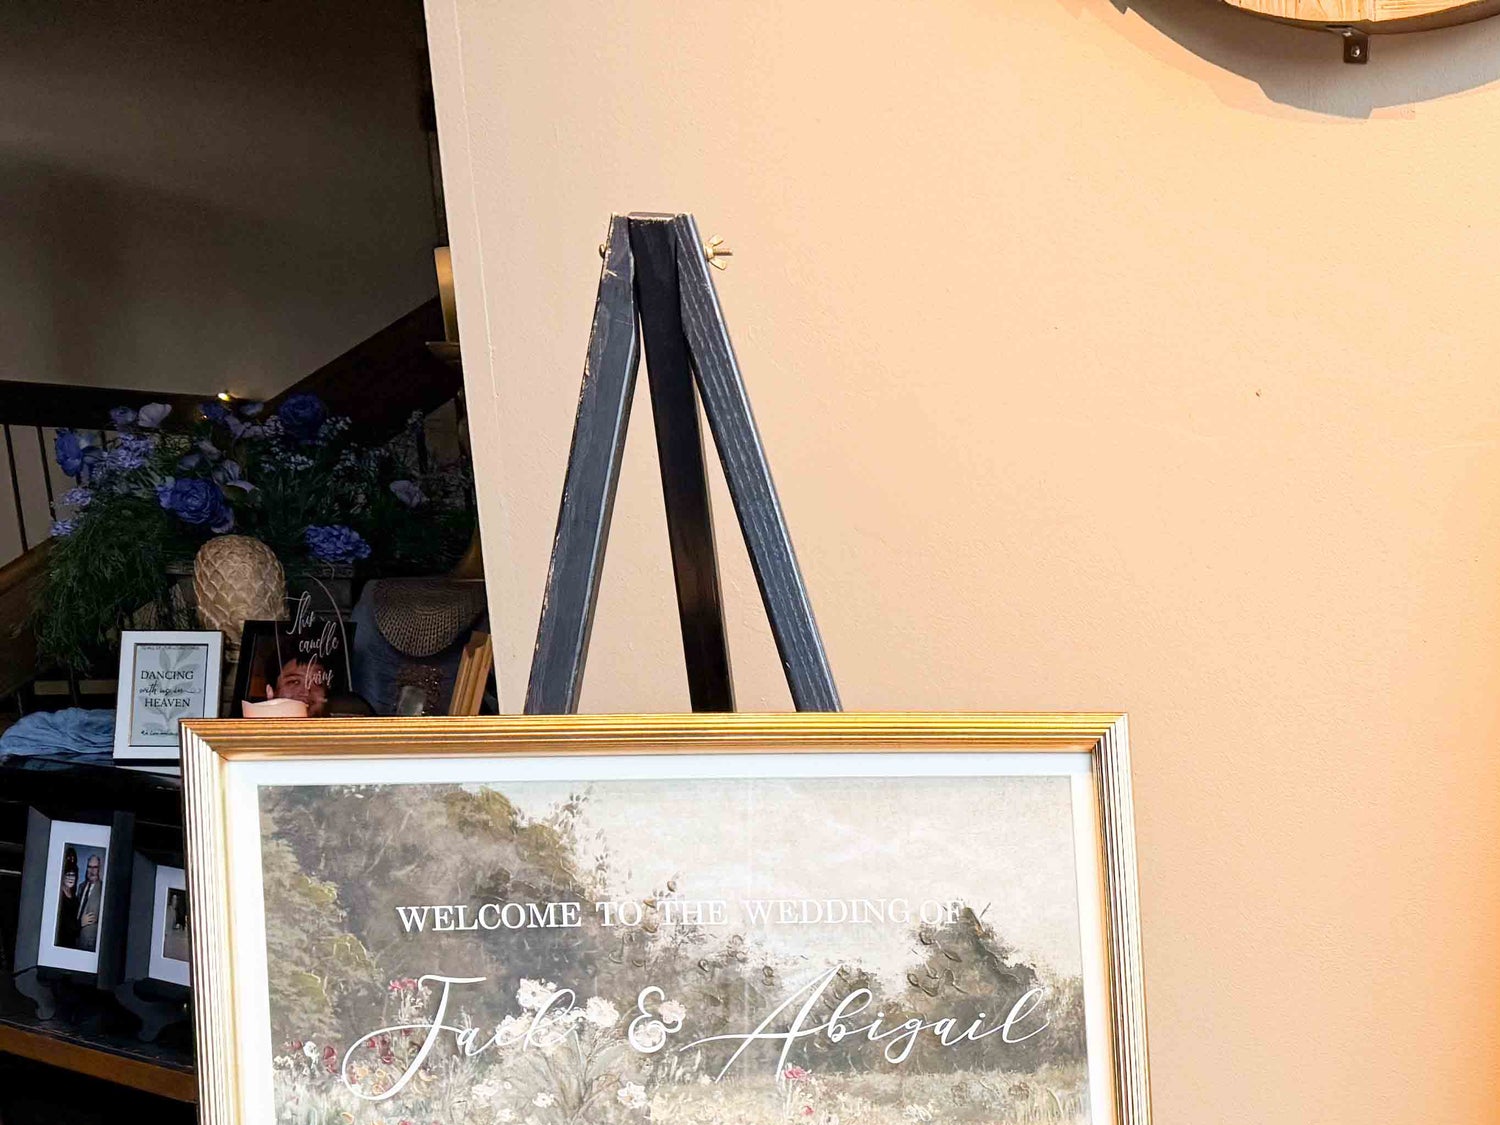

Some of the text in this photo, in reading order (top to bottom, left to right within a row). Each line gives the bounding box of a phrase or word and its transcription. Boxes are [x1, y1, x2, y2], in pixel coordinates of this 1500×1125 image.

[140, 670, 195, 680] DANCING
[144, 698, 191, 708] HEAVEN
[396, 899, 967, 932] WELCOME TO THE WEDDING OF
[342, 963, 1052, 1100] Jack & Abigail
